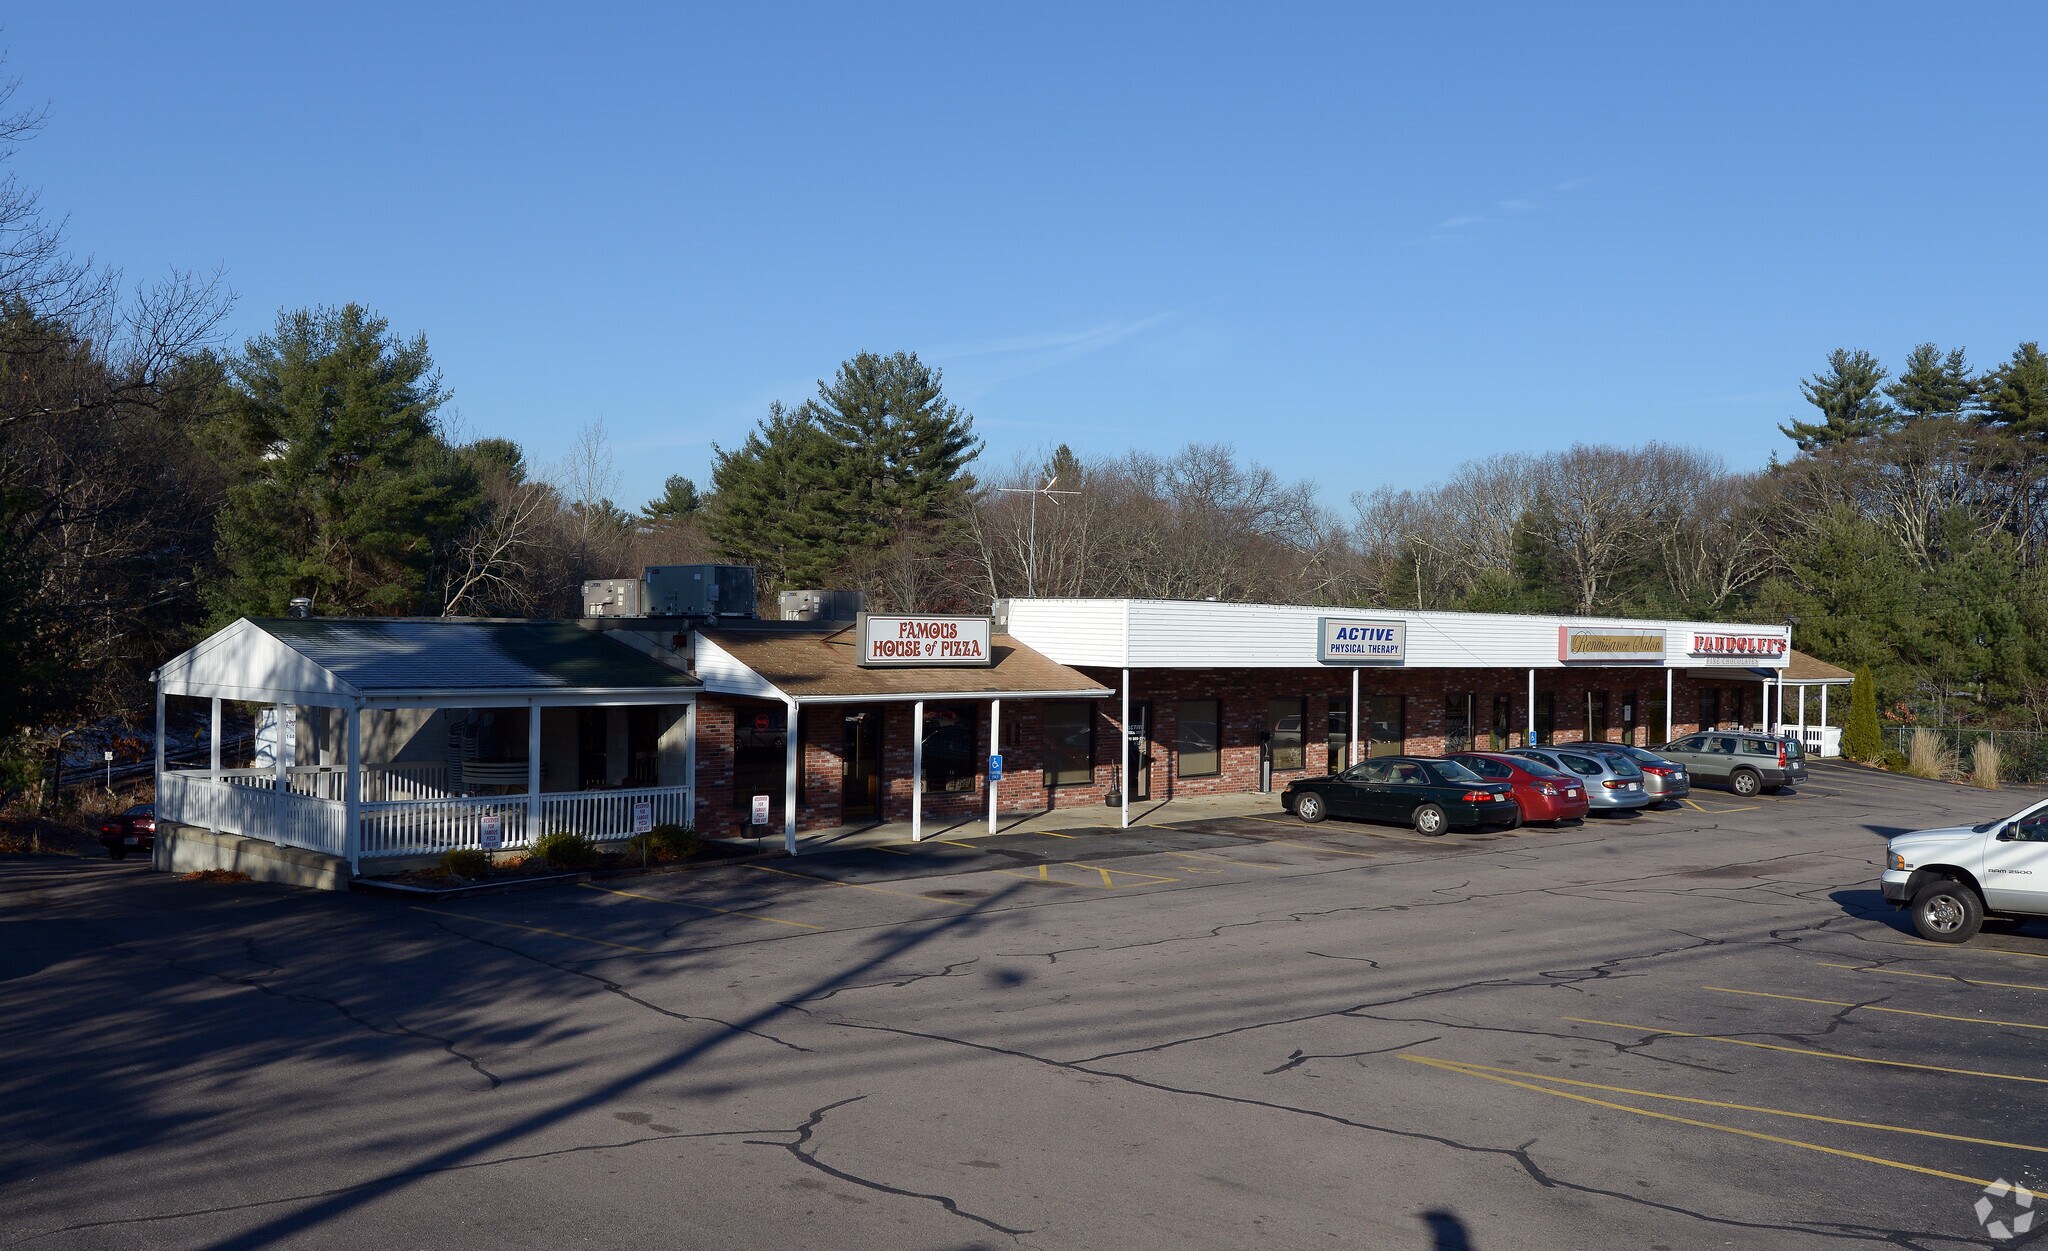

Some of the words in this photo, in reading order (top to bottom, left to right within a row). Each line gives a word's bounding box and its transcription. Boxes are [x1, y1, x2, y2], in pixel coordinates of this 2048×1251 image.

[899, 621, 957, 639] FAMOUS
[1336, 627, 1394, 641] ACTIVE
[873, 640, 921, 657] HOUSE
[925, 640, 938, 656] of
[941, 639, 981, 657] PIZZA
[1330, 643, 1365, 653] PHYSICAL
[1368, 644, 1399, 654] THERAPY
[1572, 631, 1630, 654] Renaissance
[1633, 631, 1661, 654] Salon
